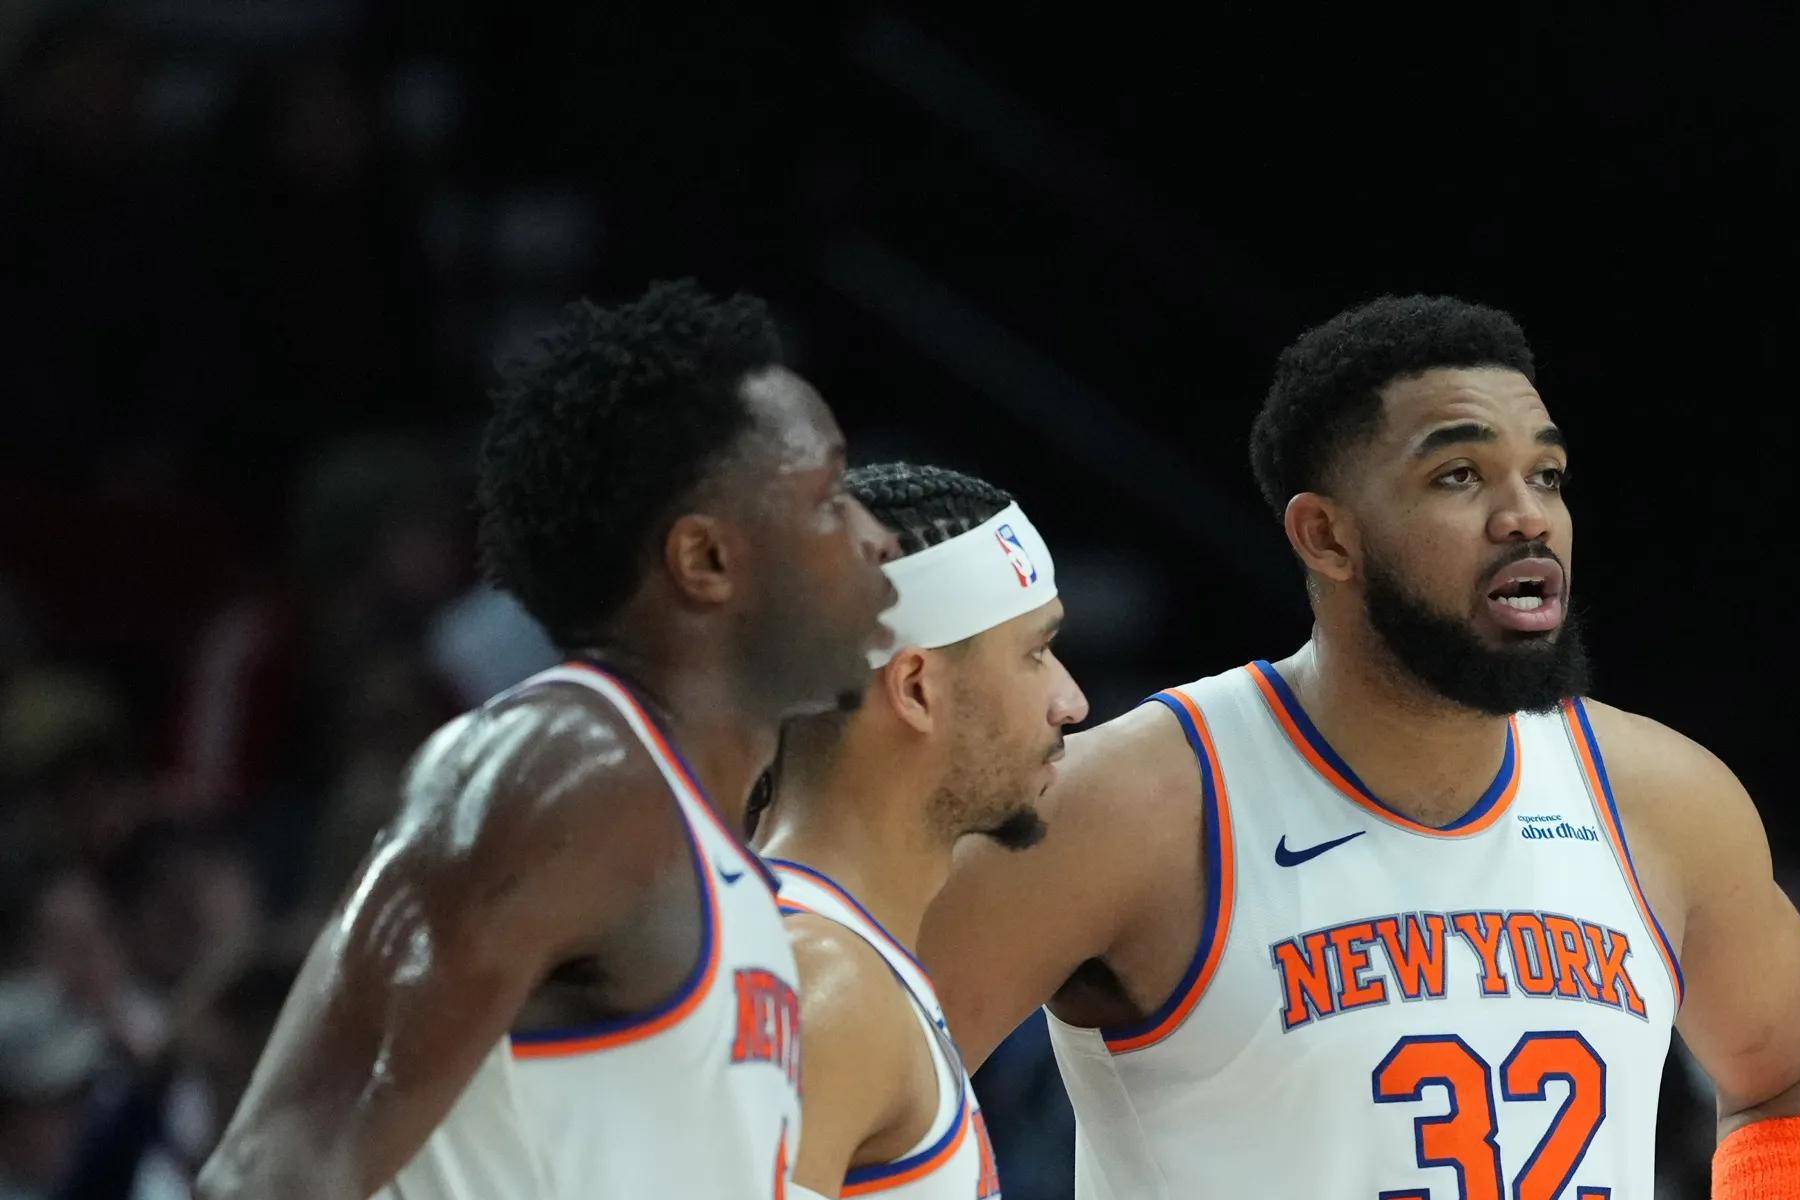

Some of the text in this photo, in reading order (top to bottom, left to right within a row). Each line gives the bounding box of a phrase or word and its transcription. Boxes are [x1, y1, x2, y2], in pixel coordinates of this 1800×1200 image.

[1517, 814, 1562, 823] experience
[1521, 822, 1600, 841] abu dhabi
[1269, 910, 1649, 1033] NEW YORK
